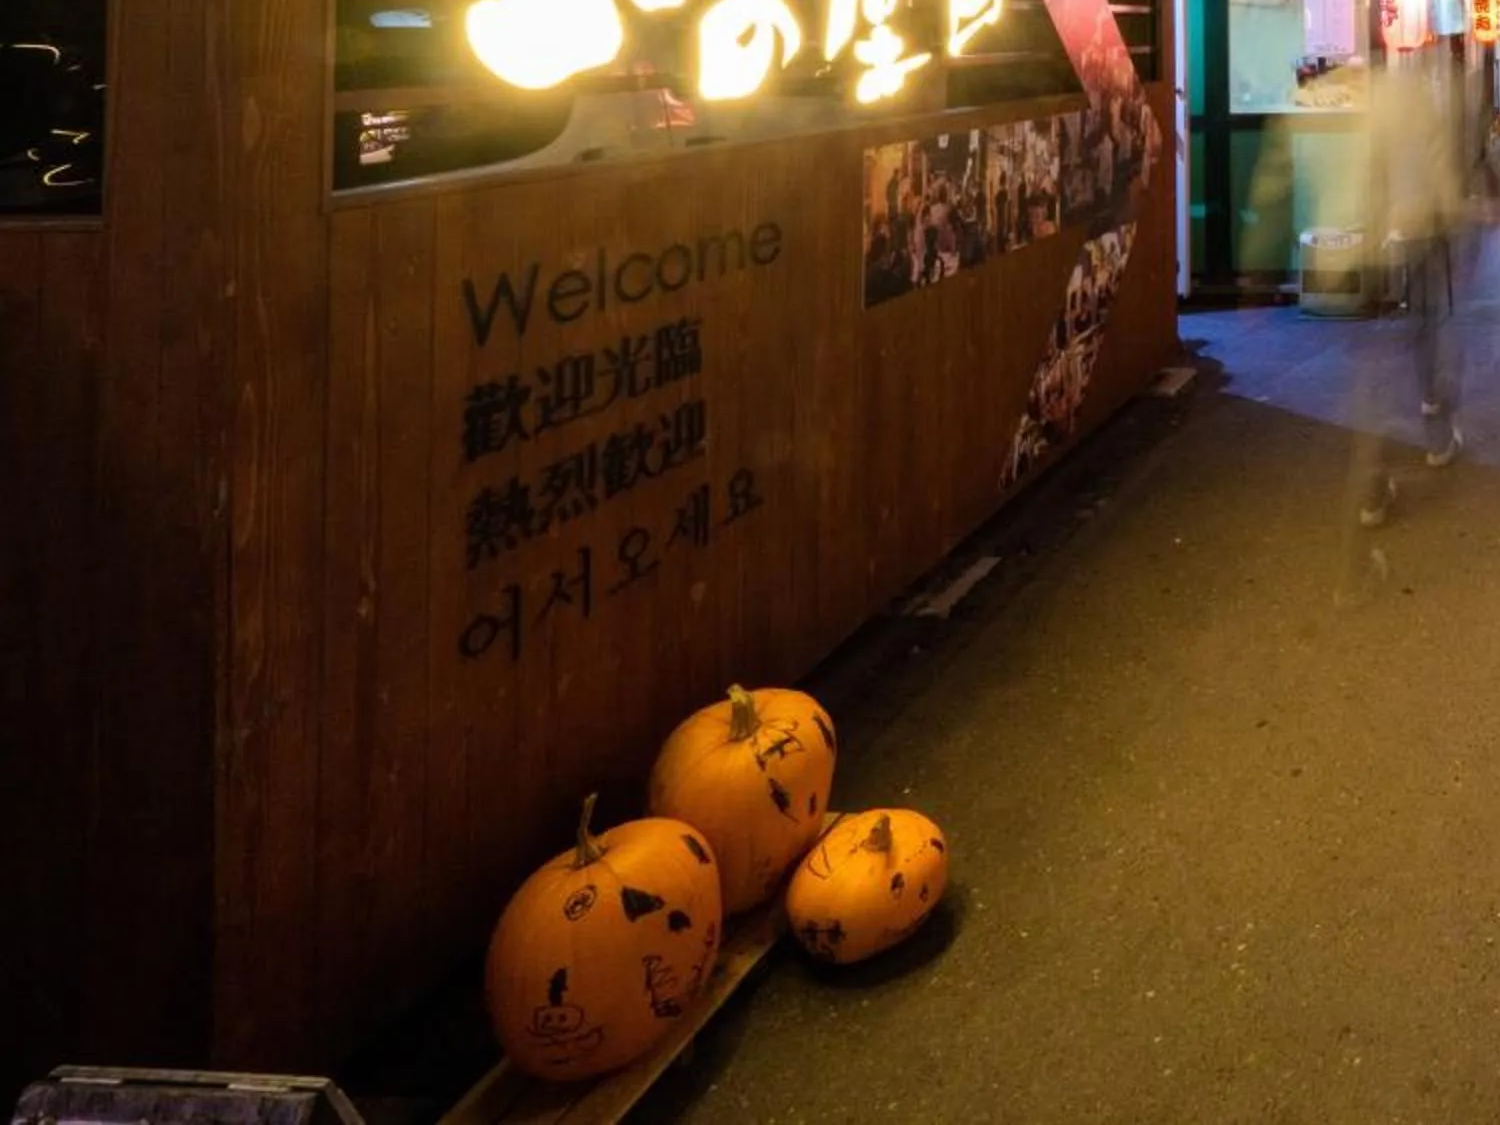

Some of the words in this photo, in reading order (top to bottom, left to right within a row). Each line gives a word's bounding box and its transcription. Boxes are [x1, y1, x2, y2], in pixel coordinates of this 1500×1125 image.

[461, 220, 783, 348] Welcome
[462, 315, 703, 463] 歡迎光臨
[457, 467, 766, 661] 어서오세요
